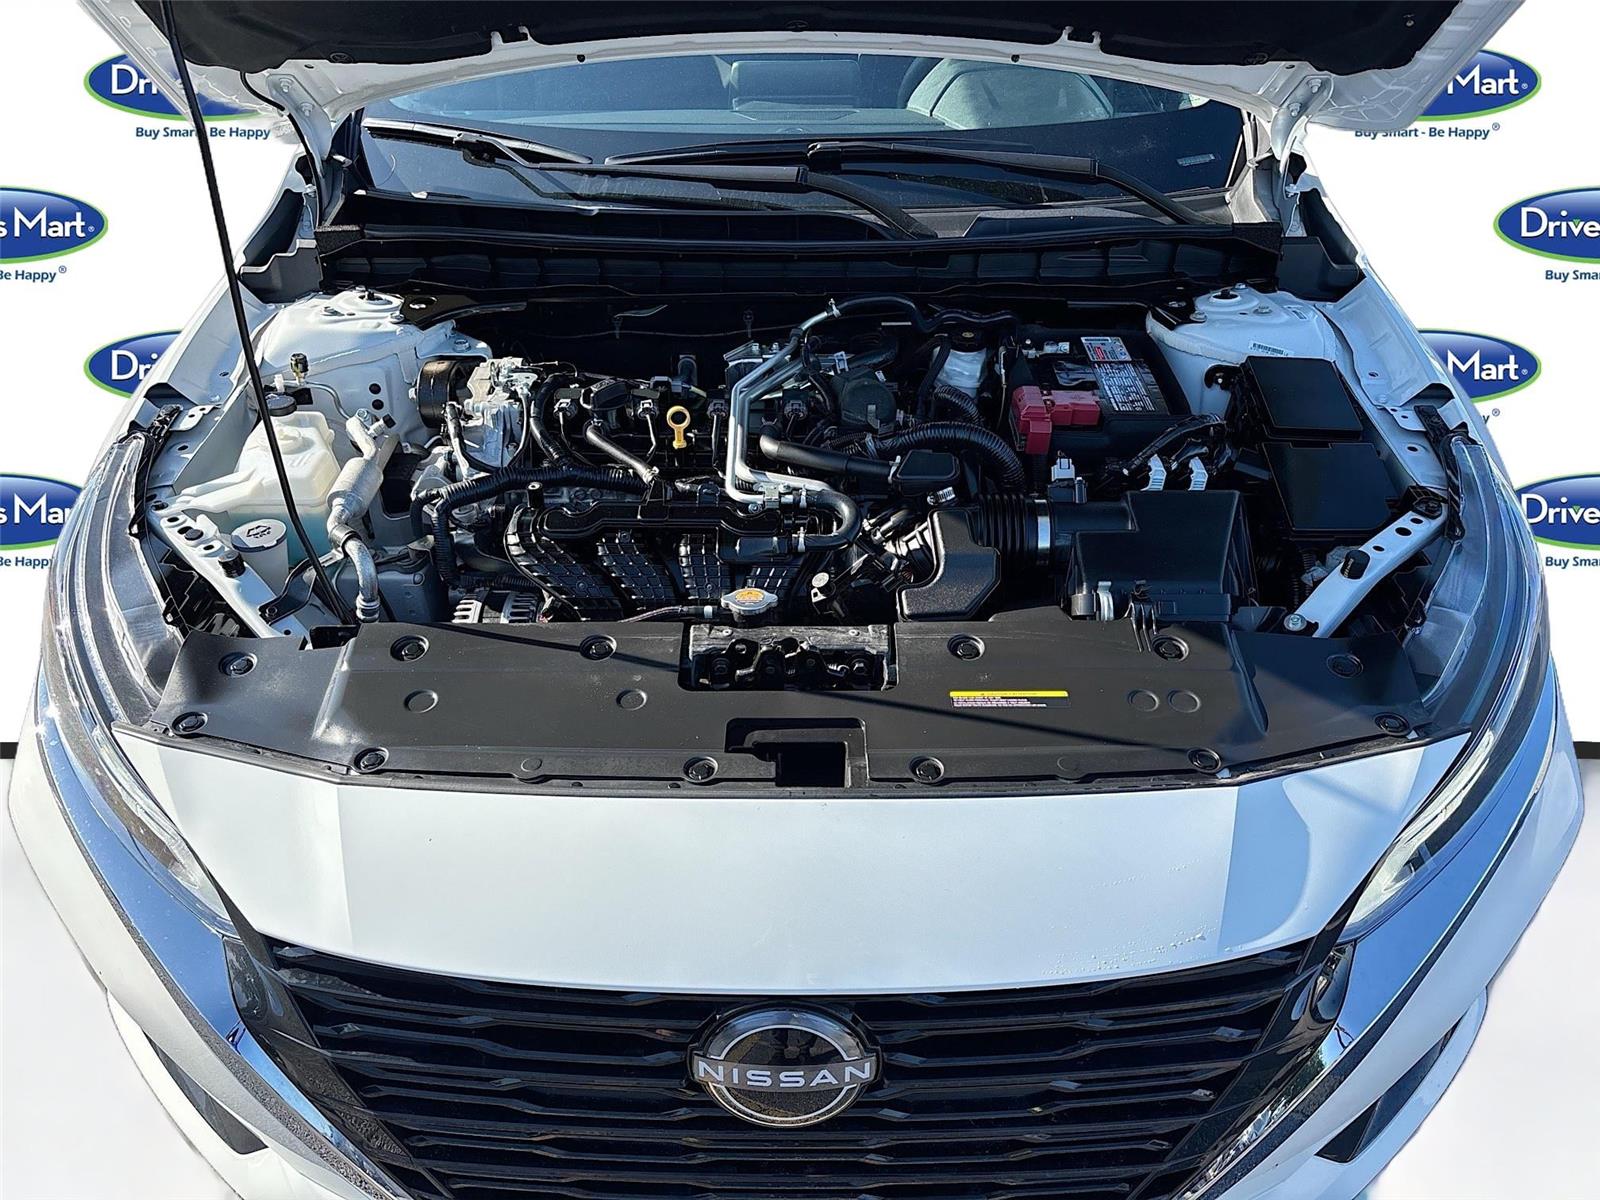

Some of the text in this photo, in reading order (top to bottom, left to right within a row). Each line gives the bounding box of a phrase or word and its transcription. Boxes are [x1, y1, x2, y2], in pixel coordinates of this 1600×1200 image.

[1447, 64, 1519, 95] Mart
[135, 127, 271, 140] Buy Smar Be Happy
[1428, 127, 1445, 138] Be
[1448, 127, 1490, 140] Happy
[14, 206, 86, 238] Mart
[1521, 206, 1600, 238] Drive
[15, 269, 57, 283] Happy
[1545, 269, 1600, 283] Buy Sma
[1447, 348, 1519, 380] Mart
[14, 492, 73, 525] Mar
[1521, 493, 1600, 525] Drive
[1545, 556, 1600, 570] Buy Sma
[697, 1059, 872, 1088] NISSAN
